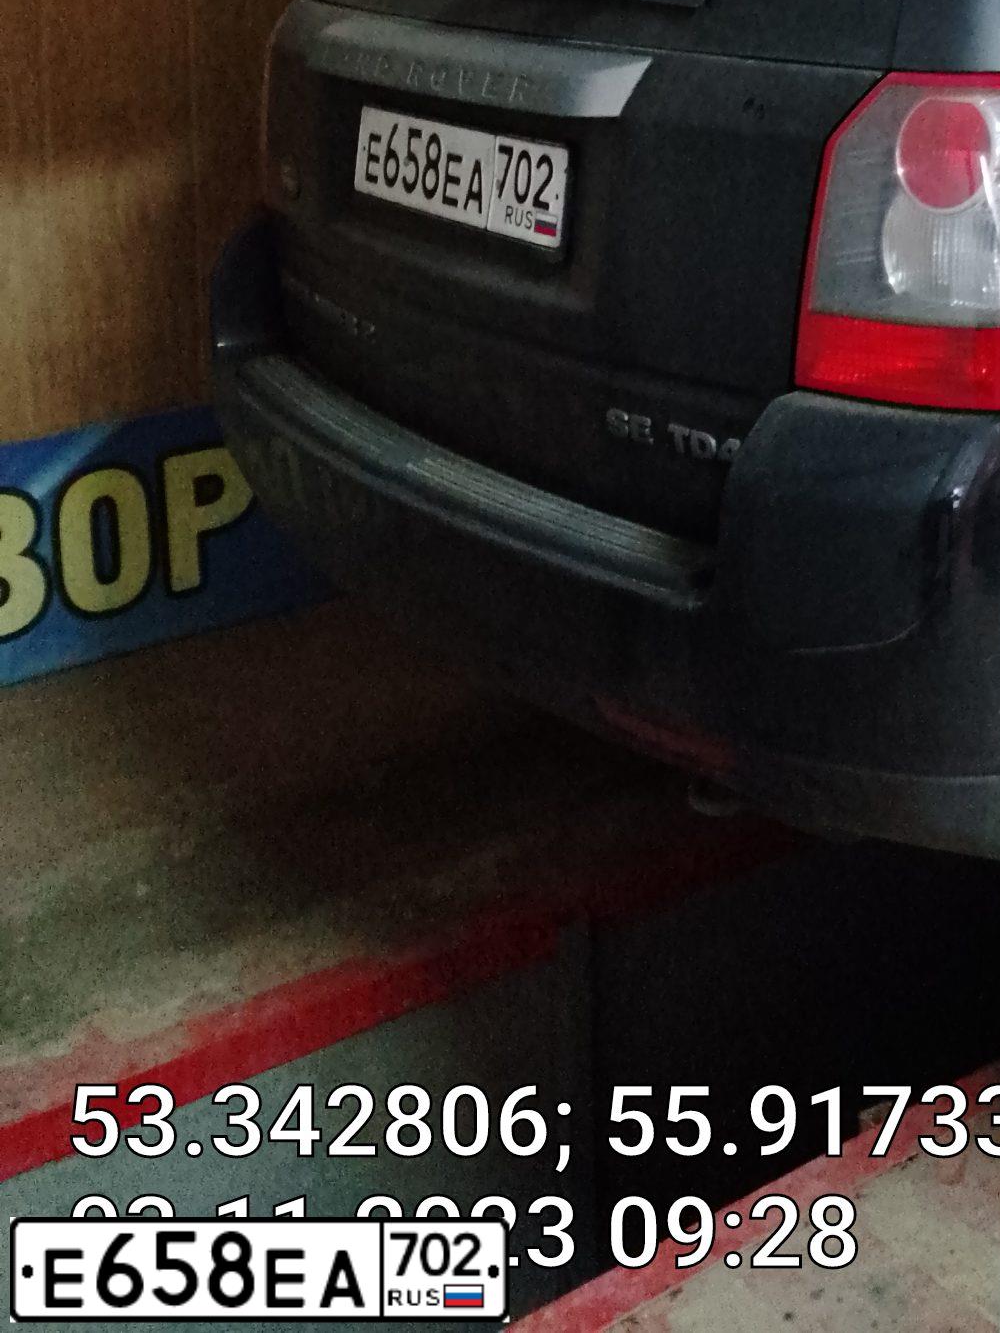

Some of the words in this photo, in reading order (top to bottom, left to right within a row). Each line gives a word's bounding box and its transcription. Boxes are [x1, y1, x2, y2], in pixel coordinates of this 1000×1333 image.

[321, 49, 390, 77] LND
[497, 144, 555, 211] 702
[504, 204, 534, 231] RUS
[606, 408, 655, 445] SE
